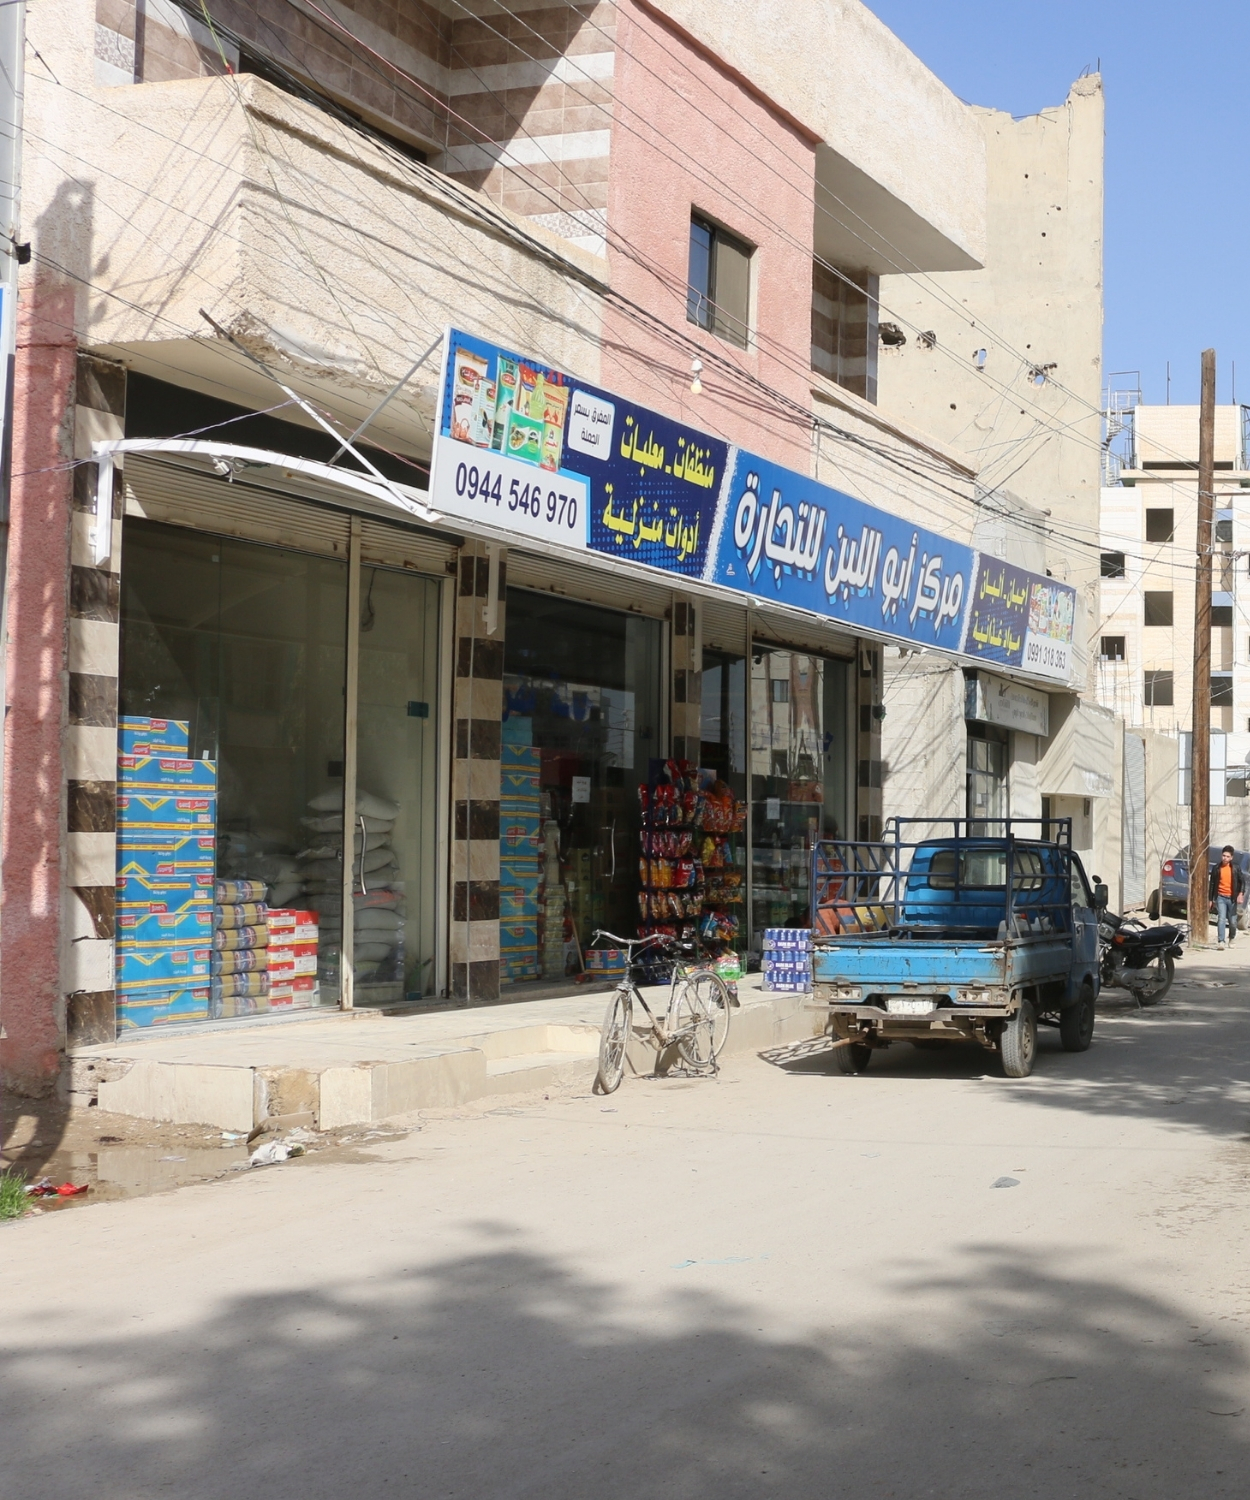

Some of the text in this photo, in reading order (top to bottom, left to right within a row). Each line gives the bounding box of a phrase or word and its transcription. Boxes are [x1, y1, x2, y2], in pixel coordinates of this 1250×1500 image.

[573, 403, 612, 425] المفرق بسعر
[581, 427, 601, 448] الجملة
[620, 415, 715, 489] منظفات معلبات
[455, 461, 578, 529] 0944 546 970
[602, 482, 700, 562] أدوات منزلية
[734, 472, 964, 632] مركز أبو اللبن للتجارة
[980, 568, 1030, 614] أجبان ألبان
[973, 610, 1021, 657] مواد غذائية
